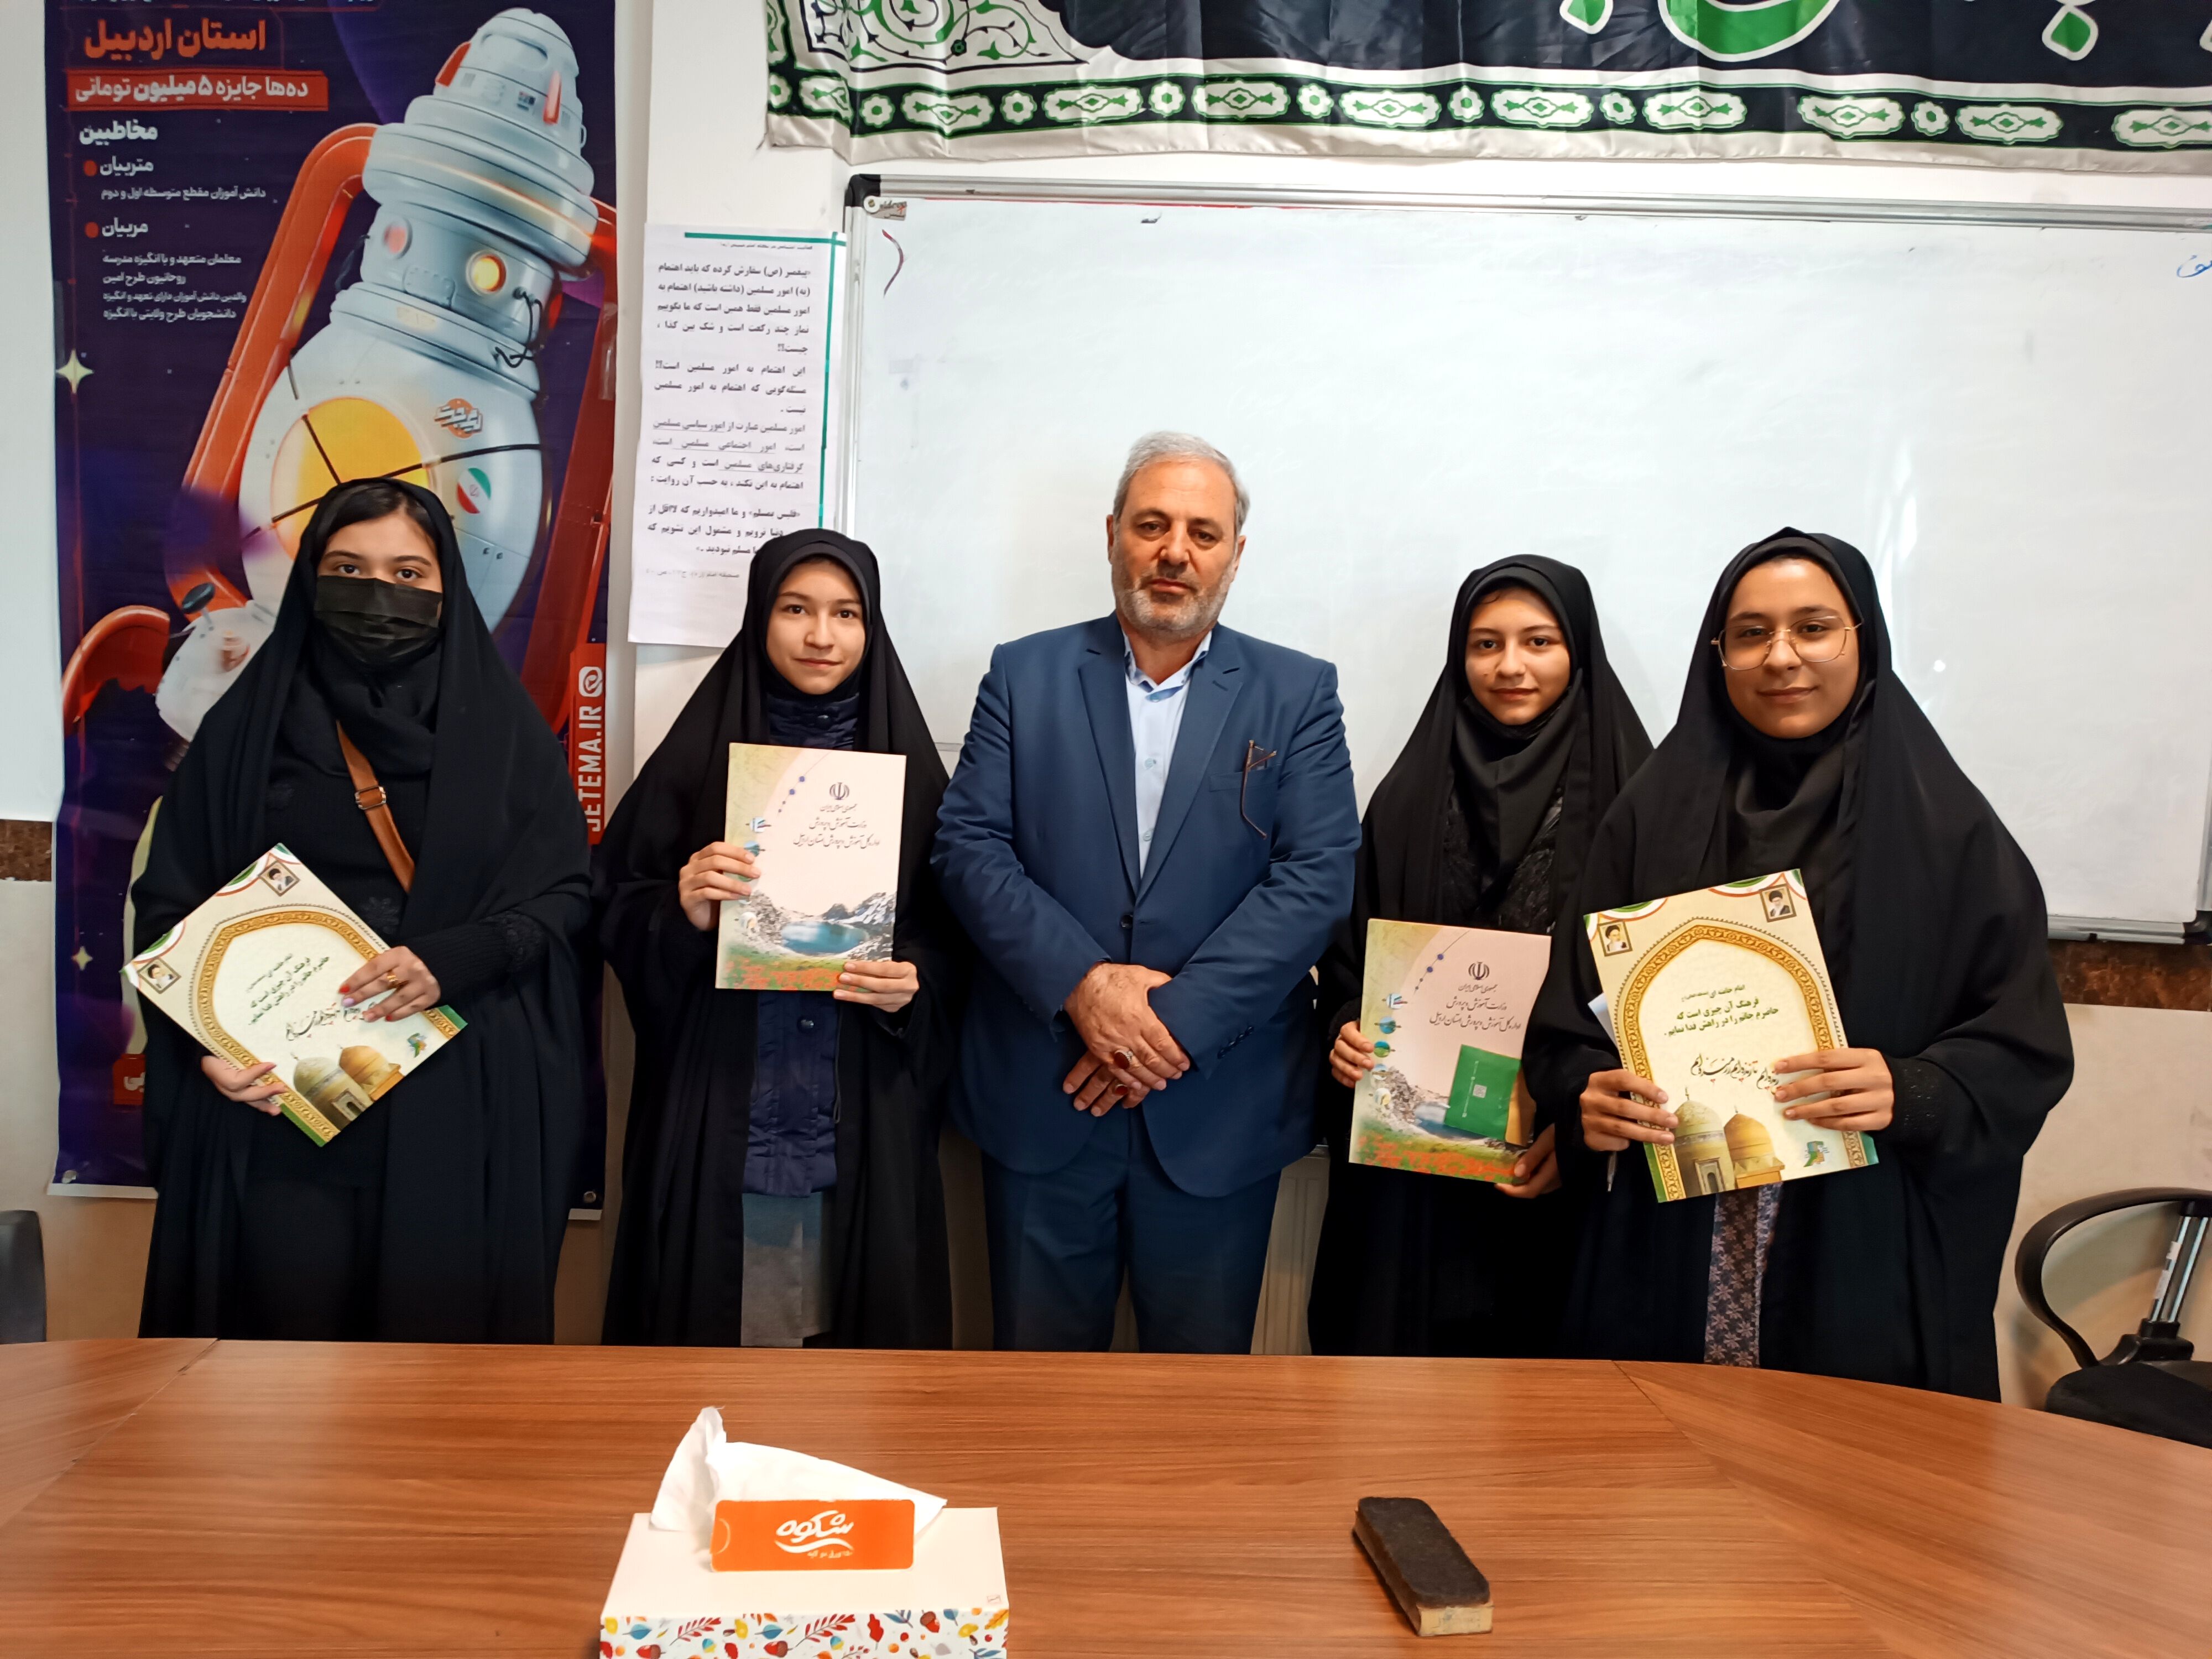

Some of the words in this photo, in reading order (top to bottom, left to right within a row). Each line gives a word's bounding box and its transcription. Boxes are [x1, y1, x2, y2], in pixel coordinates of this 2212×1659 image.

[84, 18, 172, 61] اردبیل
[176, 18, 267, 58] استان
[75, 76, 132, 102] تومانی
[133, 74, 196, 102] میلیون
[197, 75, 213, 94] ۵
[215, 76, 262, 101] جایزه
[79, 118, 158, 146] مخاطبین
[99, 155, 154, 177] متربیان
[101, 189, 119, 200] دوم
[120, 190, 126, 200] و
[127, 186, 143, 200] اول
[143, 186, 181, 200] متوسطه
[182, 186, 209, 201] مقطع
[239, 186, 267, 200] دانش
[101, 217, 149, 237] مربیان
[102, 255, 133, 266] مدرسه
[169, 256, 175, 266] و
[176, 255, 206, 266] متعهد
[659, 262, 682, 273] اهتمام
[685, 264, 699, 273] باید
[713, 265, 732, 275] کرده
[734, 266, 761, 276] سفارش
[764, 266, 782, 277] (ص)
[125, 272, 145, 286] طرح
[667, 283, 691, 292] اهتمام
[747, 285, 774, 295] مسلمین
[776, 286, 793, 297] امور
[684, 302, 690, 310] ما
[723, 306, 743, 314] همین
[746, 304, 761, 312] فقط
[763, 305, 791, 315] مسلمین
[166, 308, 186, 323] طرح
[794, 306, 810, 317] امور
[748, 324, 770, 335] رکعت
[775, 326, 789, 335] چند
[794, 325, 809, 336] نماز
[687, 362, 714, 372] مسلمین
[722, 364, 739, 374] امور
[747, 366, 754, 374] به
[761, 365, 785, 375] اهتمام
[792, 367, 805, 377] این
[654, 380, 681, 390] مسلمین
[687, 382, 704, 392] امور
[709, 384, 716, 392] به
[722, 383, 745, 393] اهتمام
[786, 405, 806, 415] نیست
[653, 418, 680, 428] مسلمین
[682, 419, 707, 430] سیاسی
[709, 421, 725, 431] امور
[727, 421, 734, 431] از
[735, 422, 758, 432] عبارت
[760, 423, 787, 433] مسلمین
[789, 425, 805, 435] امور
[682, 439, 709, 448] مسلمین
[718, 440, 752, 450] اجتماعی
[760, 442, 776, 453] امور
[667, 457, 686, 467] کسی
[724, 460, 752, 469] مسلمین
[656, 475, 679, 486] روایت
[682, 475, 694, 486] آن
[755, 480, 768, 490] این
[780, 481, 804, 491] اهتمام
[648, 504, 656, 514] از
[681, 505, 690, 513] که
[692, 507, 729, 517] امیدواریم
[731, 507, 738, 515] ما
[661, 524, 683, 534] نشویم
[688, 525, 701, 535] این
[705, 525, 731, 536] مشمول
[745, 528, 766, 538] نرویم
[732, 545, 750, 555] مسلم
[1446, 995, 1466, 1011] پرورش
[1467, 997, 1491, 1011] آموزش
[1724, 1000, 1733, 1013] آن
[1735, 997, 1759, 1008] فرهنگ
[1676, 1011, 1684, 1020] که
[1687, 1009, 1701, 1019] است
[1703, 1006, 1721, 1017] چیزی
[1756, 1007, 1778, 1019] حاضرم
[1429, 1011, 1446, 1026] اردبیل
[1443, 1013, 1462, 1026] استان
[1460, 1014, 1480, 1031] پرورش
[1481, 1016, 1505, 1030] آموزش
[1721, 1018, 1729, 1026] در
[775, 1509, 854, 1543] شکوه
